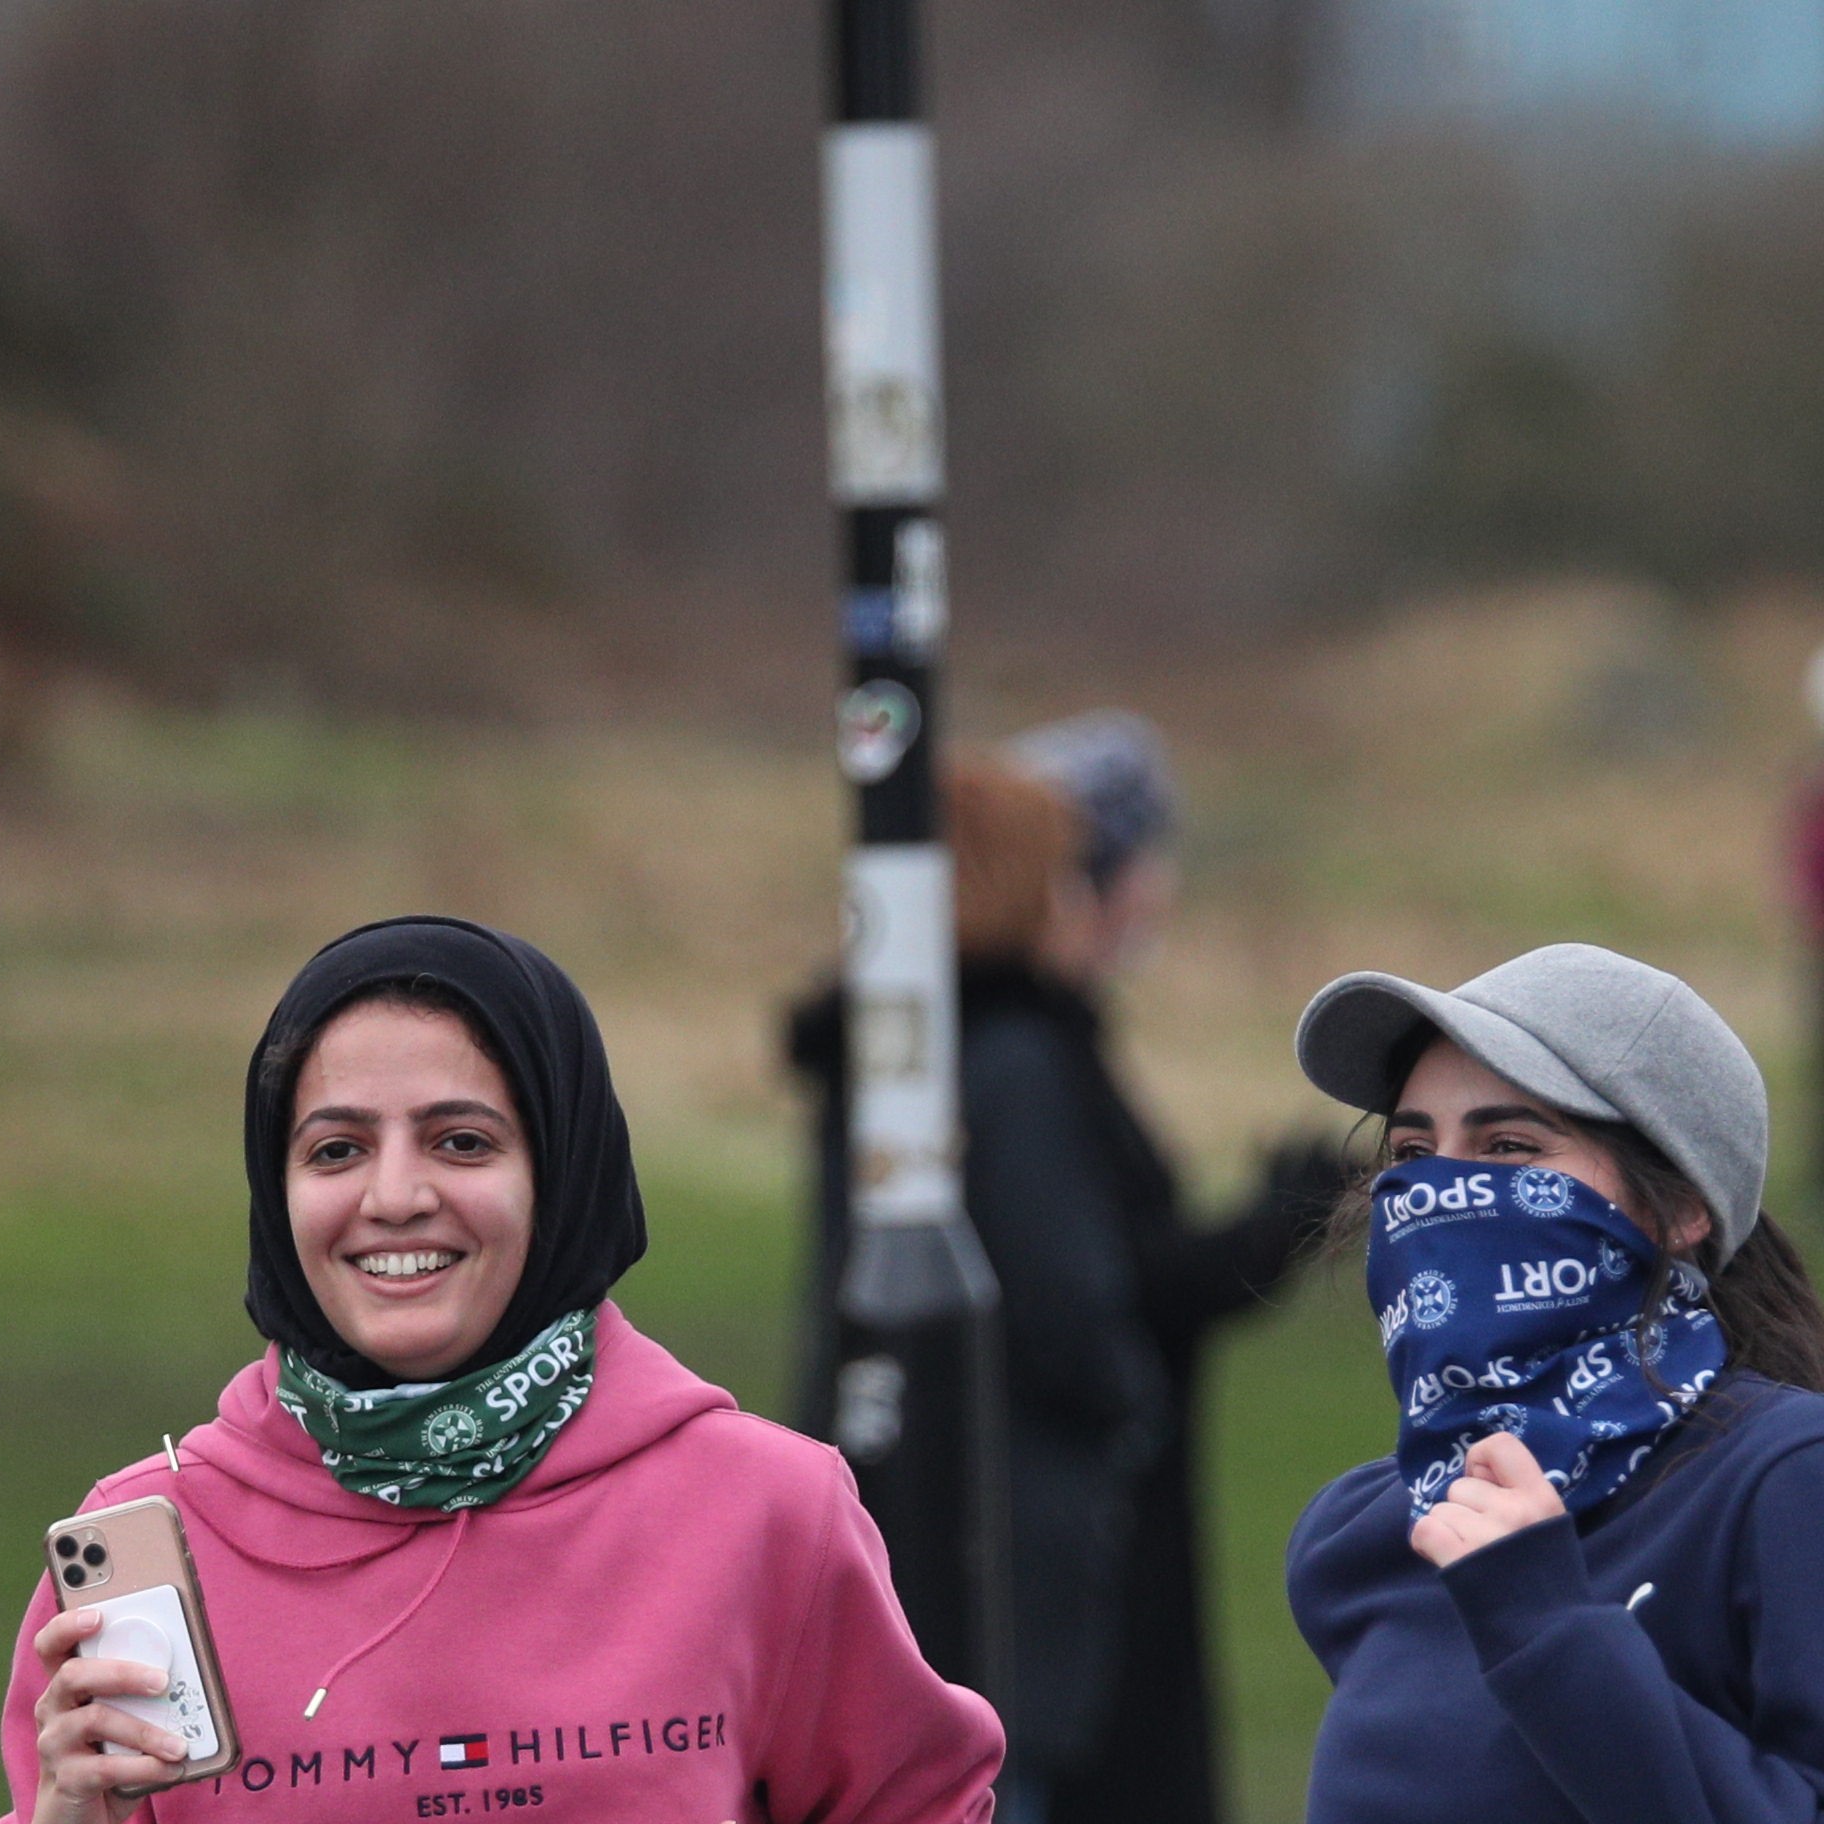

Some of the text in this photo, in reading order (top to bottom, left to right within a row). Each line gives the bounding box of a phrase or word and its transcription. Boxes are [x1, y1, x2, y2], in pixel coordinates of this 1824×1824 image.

[1383, 1172, 1496, 1232] SPORT
[1494, 1257, 1597, 1301] ORT
[1496, 1300, 1555, 1313] EDINBURGH
[1408, 1355, 1521, 1417] SPORT
[214, 1713, 726, 1795] OMMY HILFIGER
[417, 1775, 544, 1817] EST. 1985
